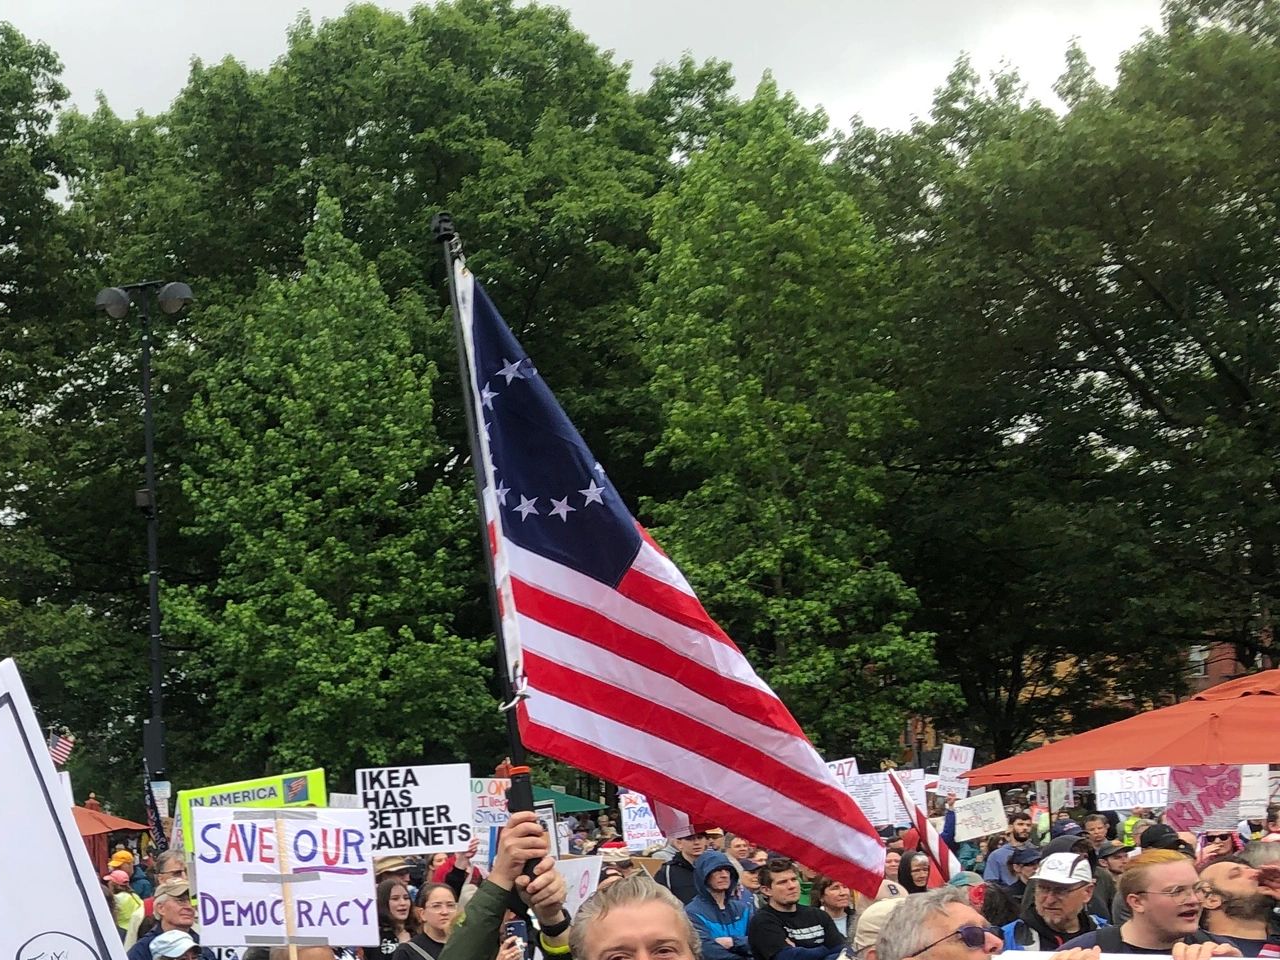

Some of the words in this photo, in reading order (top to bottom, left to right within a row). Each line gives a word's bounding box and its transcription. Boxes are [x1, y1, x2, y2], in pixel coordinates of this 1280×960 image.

[360, 768, 419, 791] IKEA
[209, 786, 278, 807] AMERICA
[362, 789, 413, 809] HAS
[198, 822, 275, 864] SAVE
[293, 828, 366, 866] OUR
[199, 891, 374, 928] DEMOCRACY
